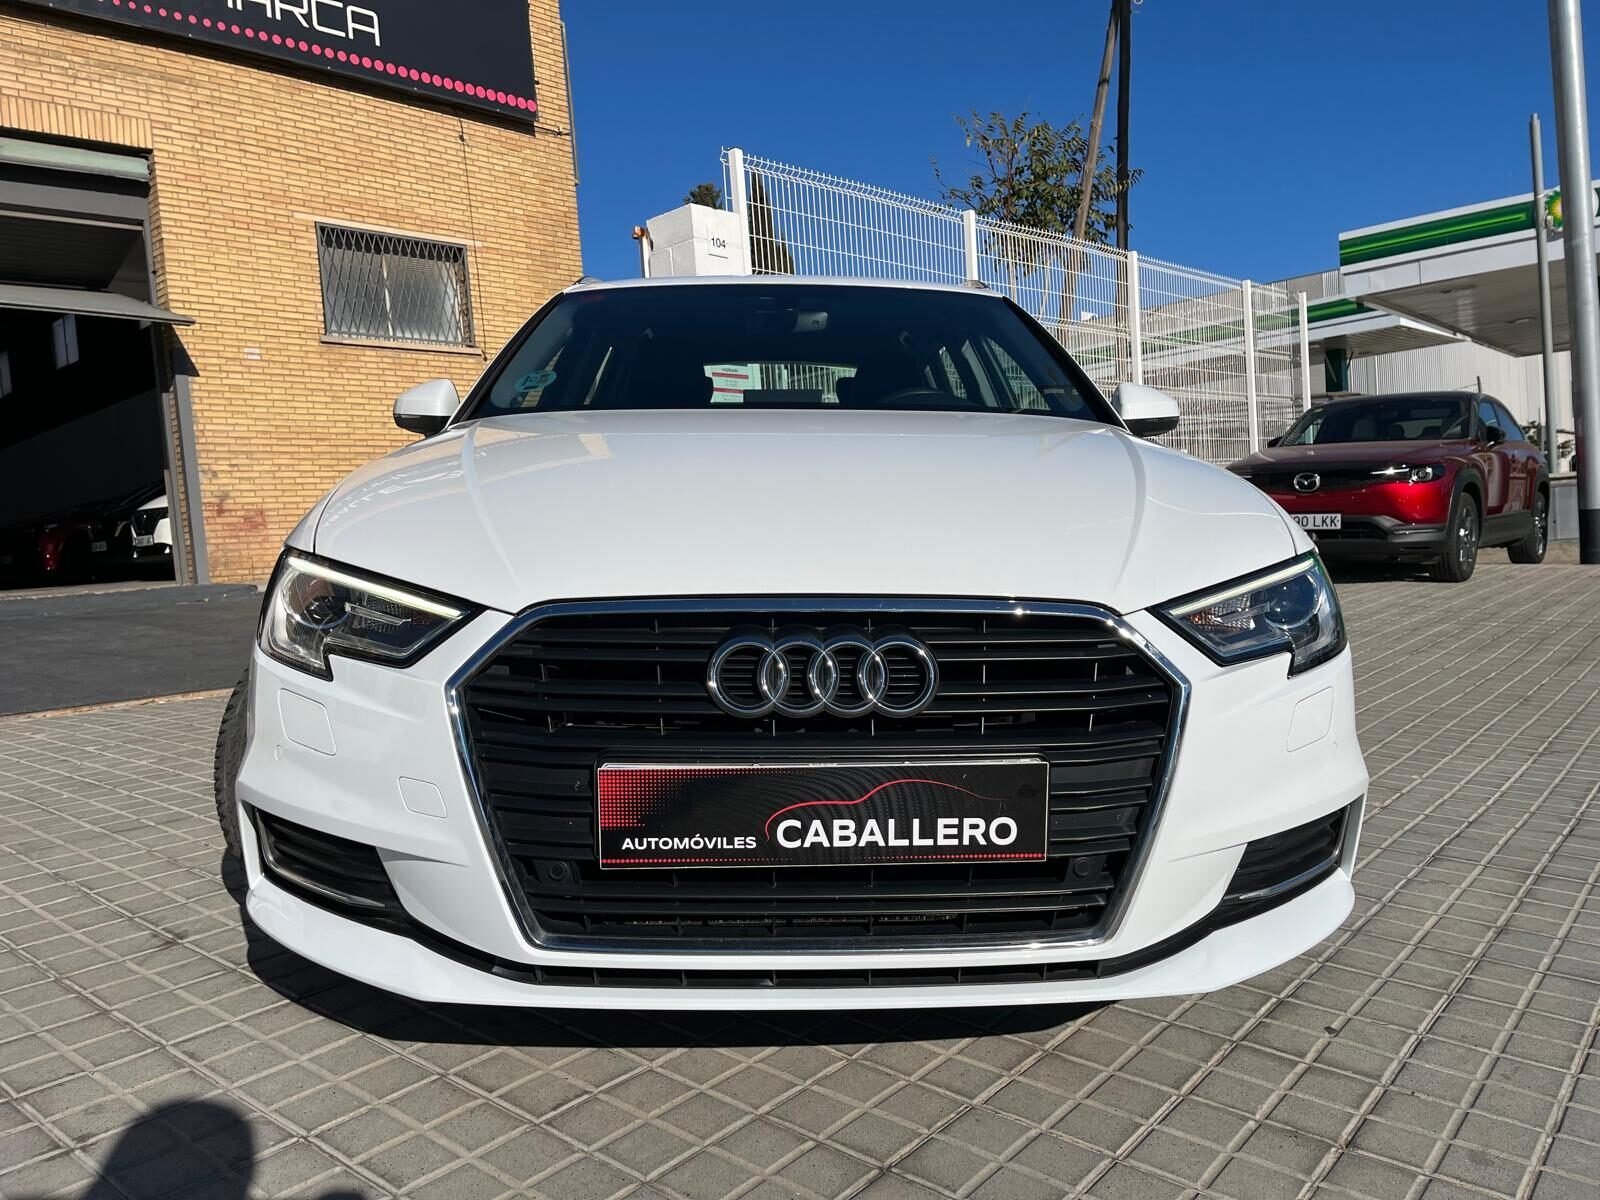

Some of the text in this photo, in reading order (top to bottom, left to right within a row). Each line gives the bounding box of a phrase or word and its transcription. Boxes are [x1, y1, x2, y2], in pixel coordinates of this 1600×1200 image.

[226, 0, 381, 47] RCA
[711, 237, 726, 249] 104
[1313, 516, 1337, 527] LKK
[621, 816, 1018, 850] AUTOMÓVILES CABALLERO
